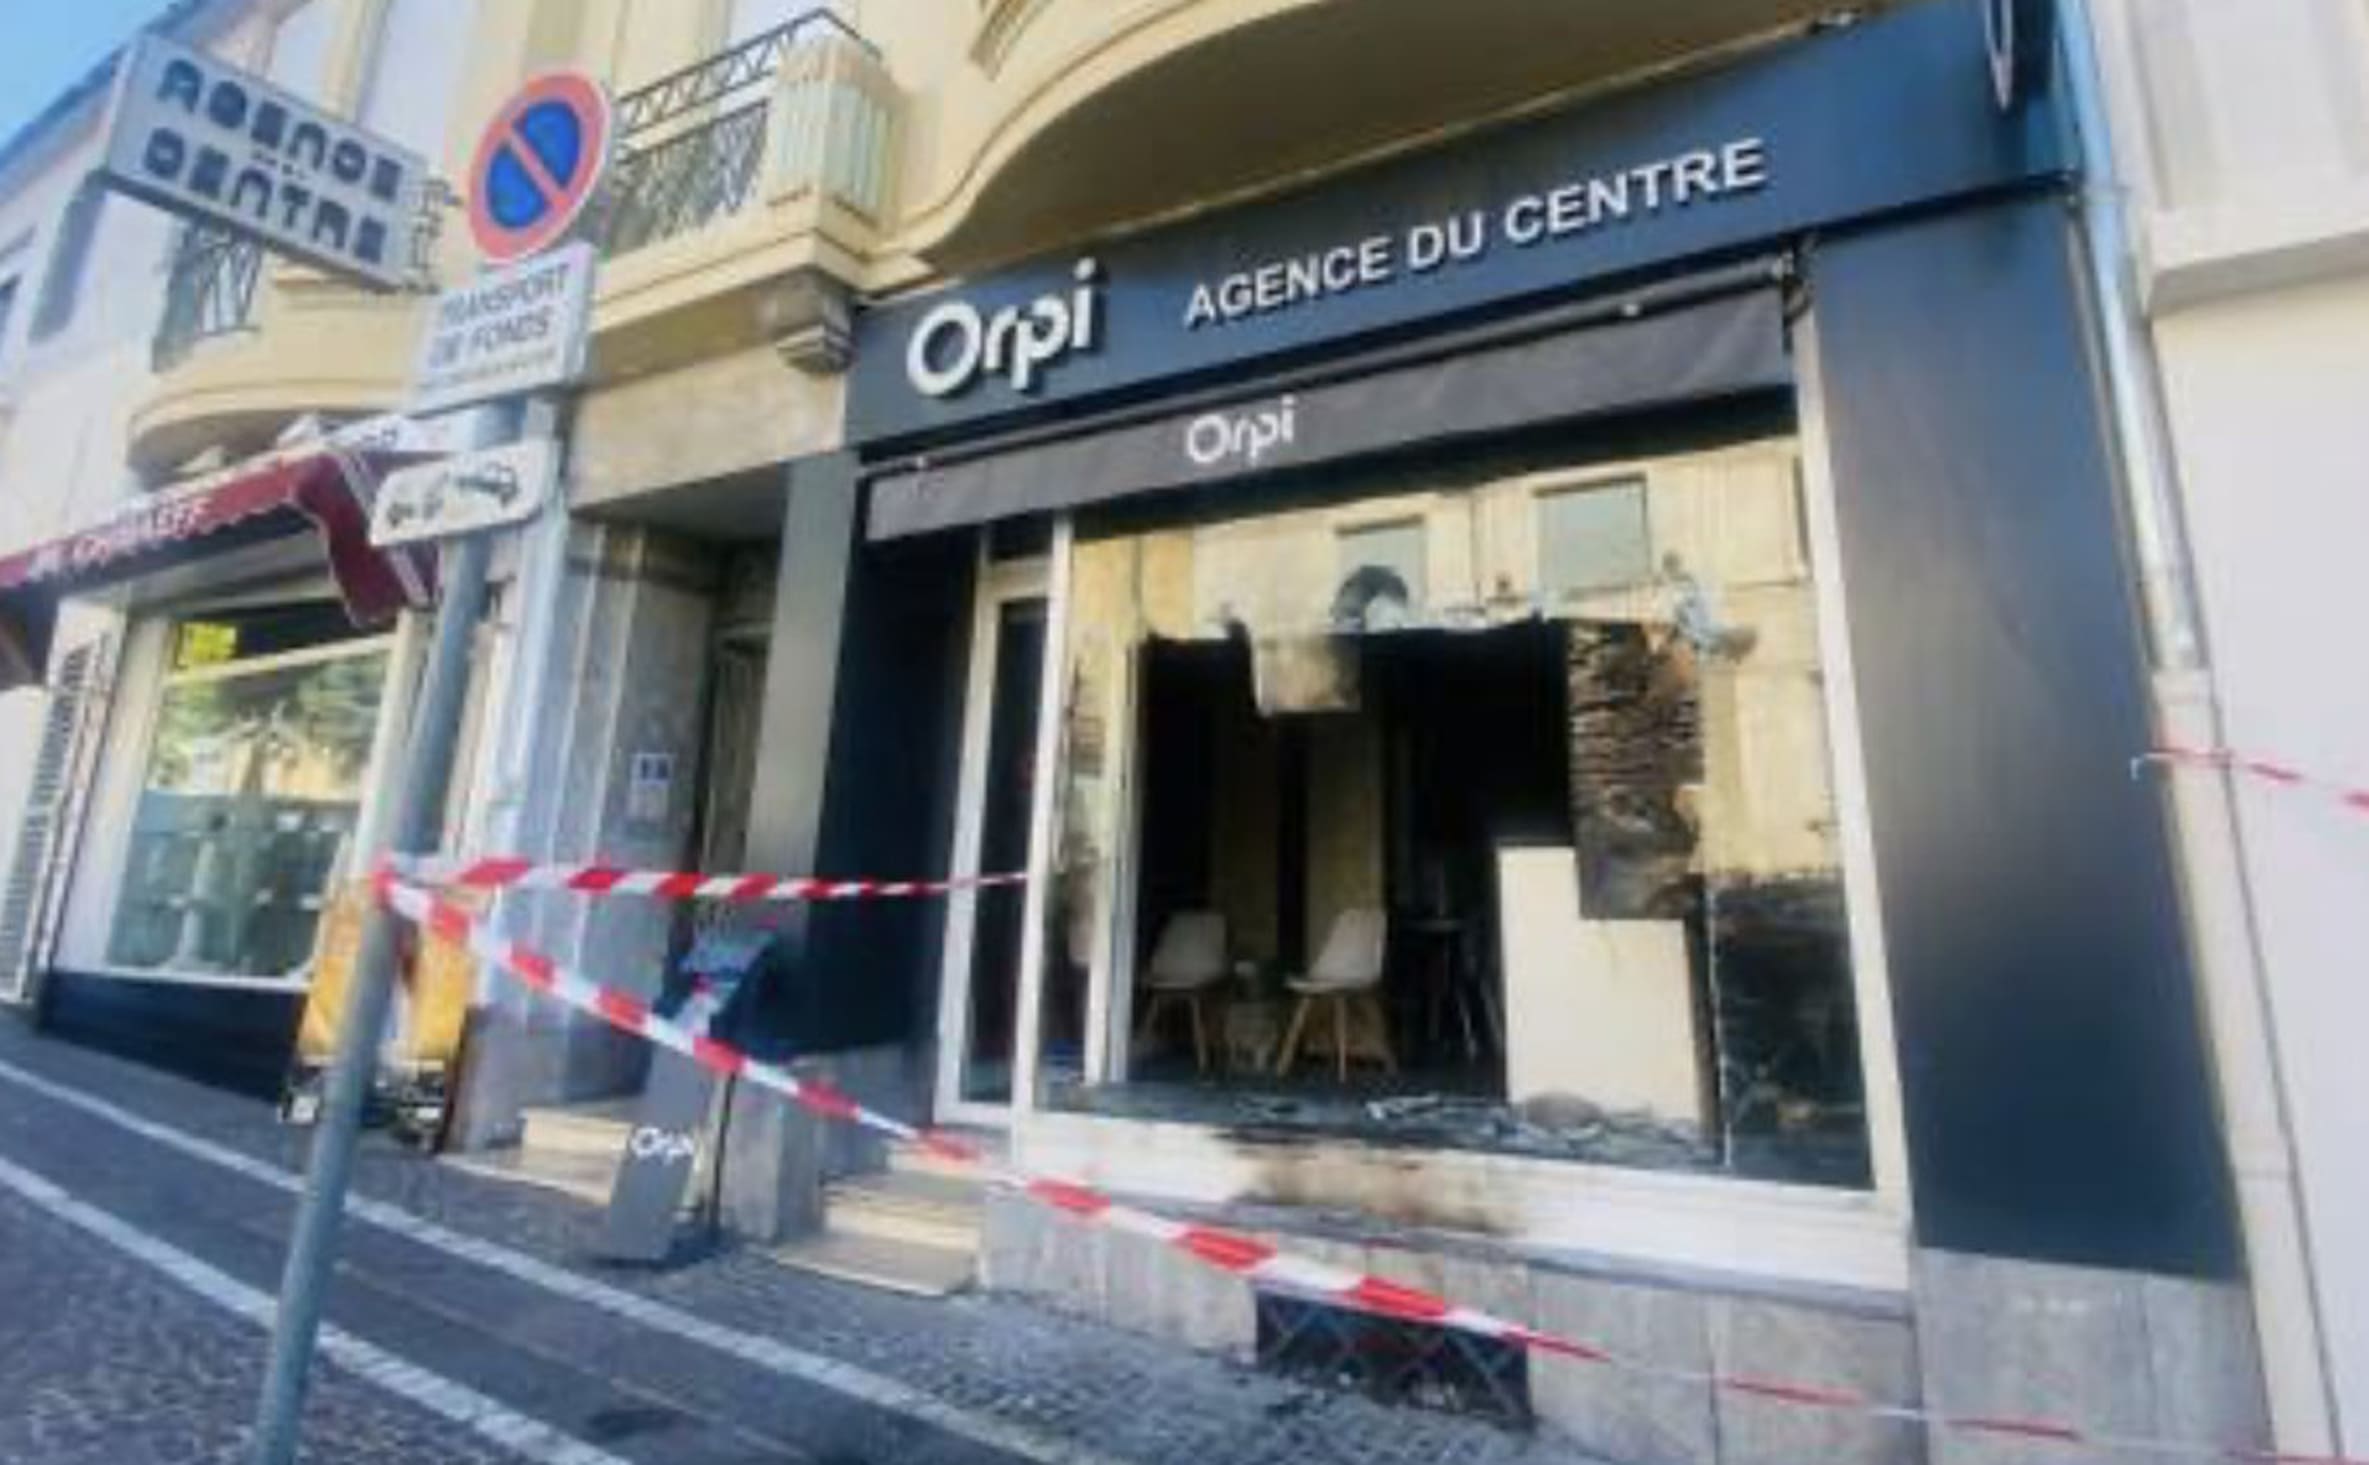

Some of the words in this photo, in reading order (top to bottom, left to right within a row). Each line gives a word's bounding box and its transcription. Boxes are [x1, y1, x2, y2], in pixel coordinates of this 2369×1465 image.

[1183, 235, 1392, 328] AGENCE
[1406, 209, 1486, 270] DU
[1503, 137, 1768, 244] CENTRE
[466, 307, 550, 353] FONDS
[906, 257, 1097, 396] Orpi
[1186, 394, 1297, 465] Orpi
